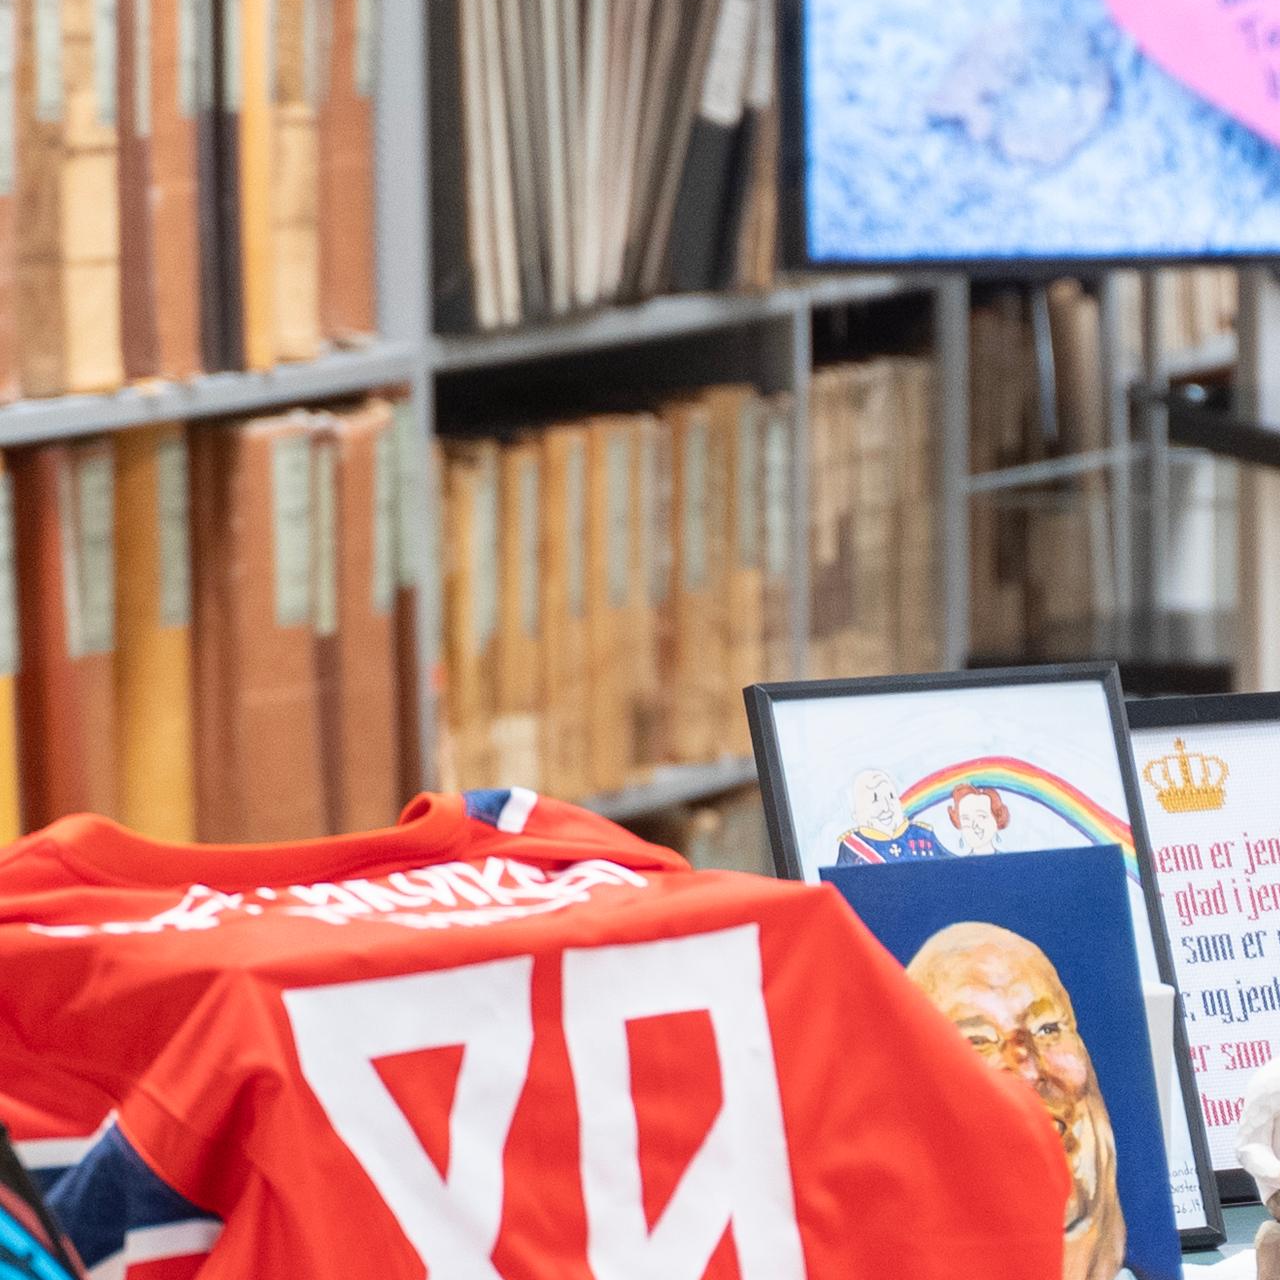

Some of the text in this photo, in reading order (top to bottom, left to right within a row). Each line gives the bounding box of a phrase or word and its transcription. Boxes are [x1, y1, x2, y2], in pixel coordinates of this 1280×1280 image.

[1210, 840, 1235, 869] er
[1174, 879, 1229, 927] glad
[1232, 878, 1243, 914] i
[1181, 930, 1235, 965] som
[1241, 927, 1267, 960] er
[1201, 987, 1234, 1024] og
[1220, 1037, 1273, 1072] som
